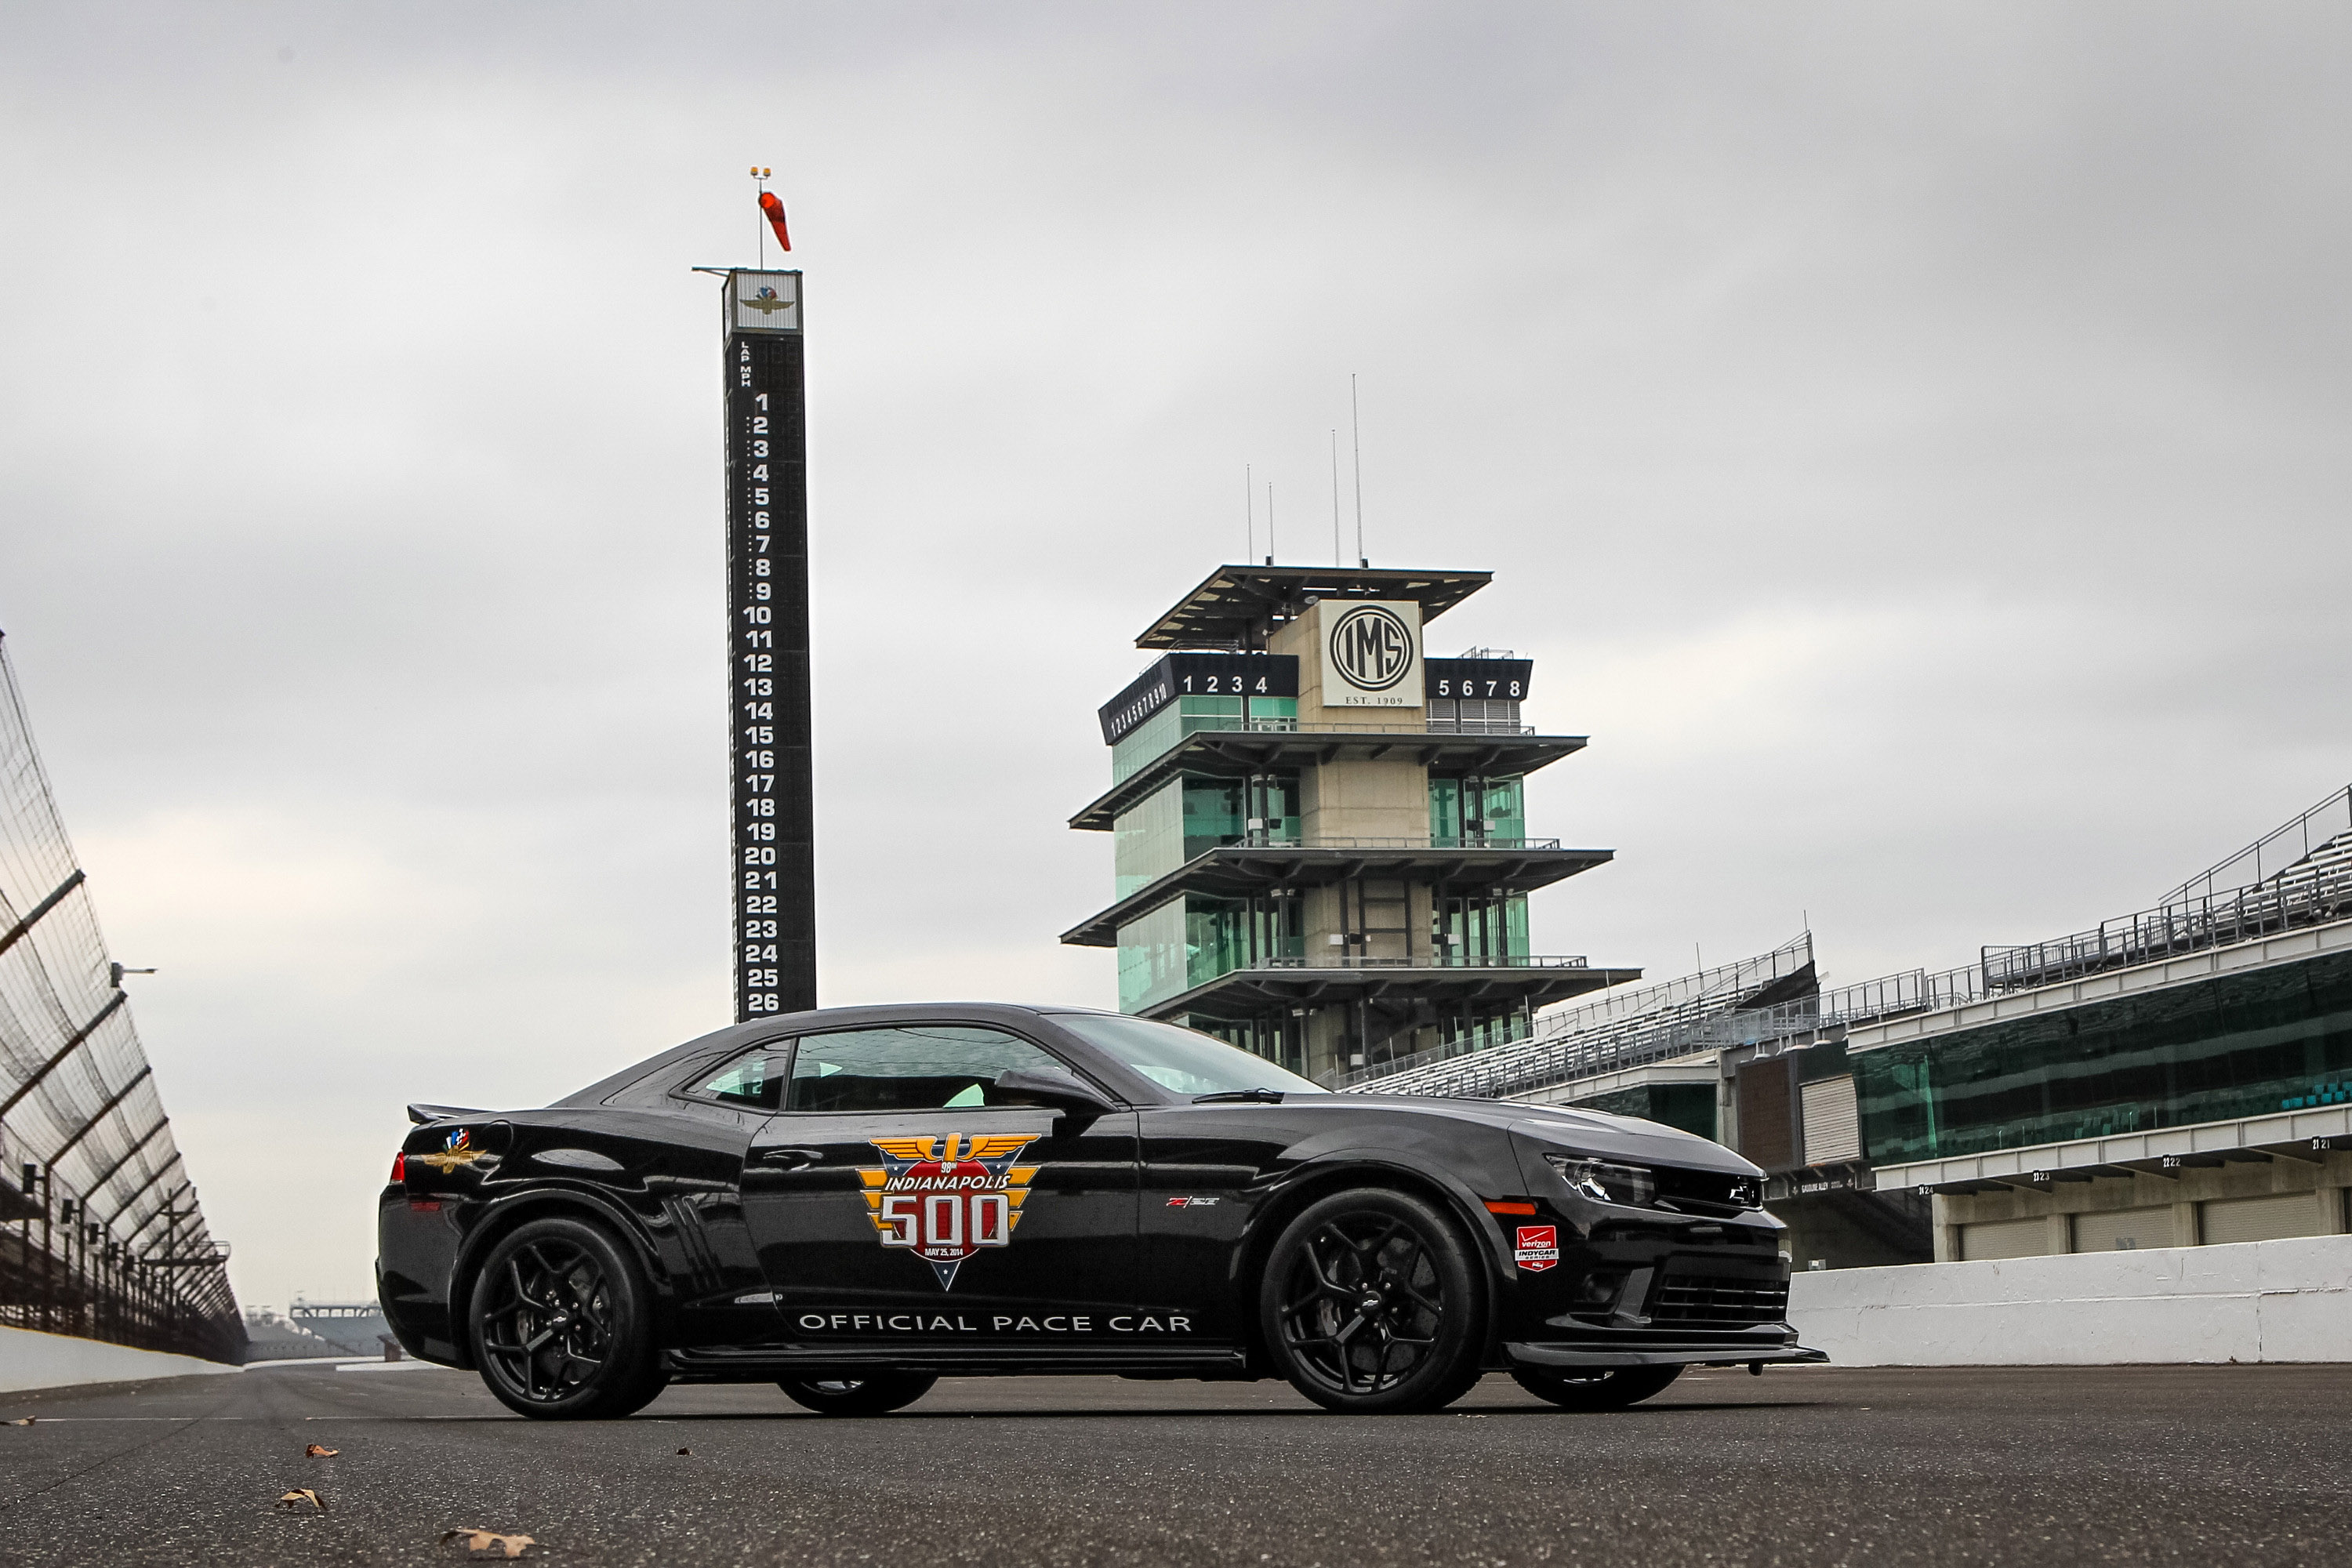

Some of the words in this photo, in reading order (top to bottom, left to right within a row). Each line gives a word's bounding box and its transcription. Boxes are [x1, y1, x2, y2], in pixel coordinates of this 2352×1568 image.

[741, 341, 750, 362] LAP
[741, 366, 751, 387] MPH
[755, 393, 768, 411] 1
[753, 416, 768, 434] 2
[753, 440, 769, 458] 3
[753, 463, 769, 481] 4
[754, 488, 769, 506] 5
[754, 510, 770, 528] 6
[755, 535, 770, 553] 7
[755, 558, 771, 576] 8
[755, 582, 771, 601] 9
[742, 606, 772, 624] 10
[745, 630, 772, 648] 11
[1345, 617, 1402, 679] IMS
[743, 654, 772, 672] 12
[743, 677, 773, 696] 13
[1183, 675, 1192, 692] 1
[1207, 676, 1218, 692] 2
[1232, 676, 1243, 692] 3
[1255, 677, 1267, 693] 4
[1439, 680, 1450, 696] 5
[1462, 680, 1473, 696] 6
[1486, 681, 1497, 697] 7
[1509, 681, 1520, 697] 8
[1345, 696, 1370, 705] EST.
[744, 702, 773, 720] 14
[1111, 721, 1116, 737] 1
[1116, 717, 1121, 734] 2
[1121, 713, 1126, 729] 3
[1127, 710, 1132, 725] 4
[1131, 705, 1137, 721] 5
[1138, 701, 1143, 717] 6
[1142, 696, 1148, 713] 7
[1148, 692, 1153, 709] 8
[1153, 688, 1159, 704] 9
[1159, 683, 1167, 701] 10
[745, 726, 774, 745] 15
[745, 750, 775, 768] 16
[746, 774, 775, 793] 17
[746, 798, 775, 817] 18
[746, 822, 775, 840] 19
[744, 847, 776, 866] 20
[744, 871, 777, 890] 21
[746, 895, 777, 914] 22
[746, 920, 778, 938] 23
[745, 944, 778, 963] 24
[747, 968, 779, 987] 25
[747, 993, 779, 1011] 26
[2321, 1139, 2330, 1149] 21
[2170, 1157, 2180, 1167] 22
[885, 1174, 1011, 1191] INDIANAPOLIS
[2040, 1172, 2050, 1181] 23
[881, 1194, 1009, 1247] 500
[925, 1247, 939, 1256] MAY
[1522, 1240, 1551, 1248] verizon
[799, 1314, 977, 1330] OFFICIAL
[993, 1316, 1092, 1331] PACE
[1109, 1316, 1192, 1331] CAR
